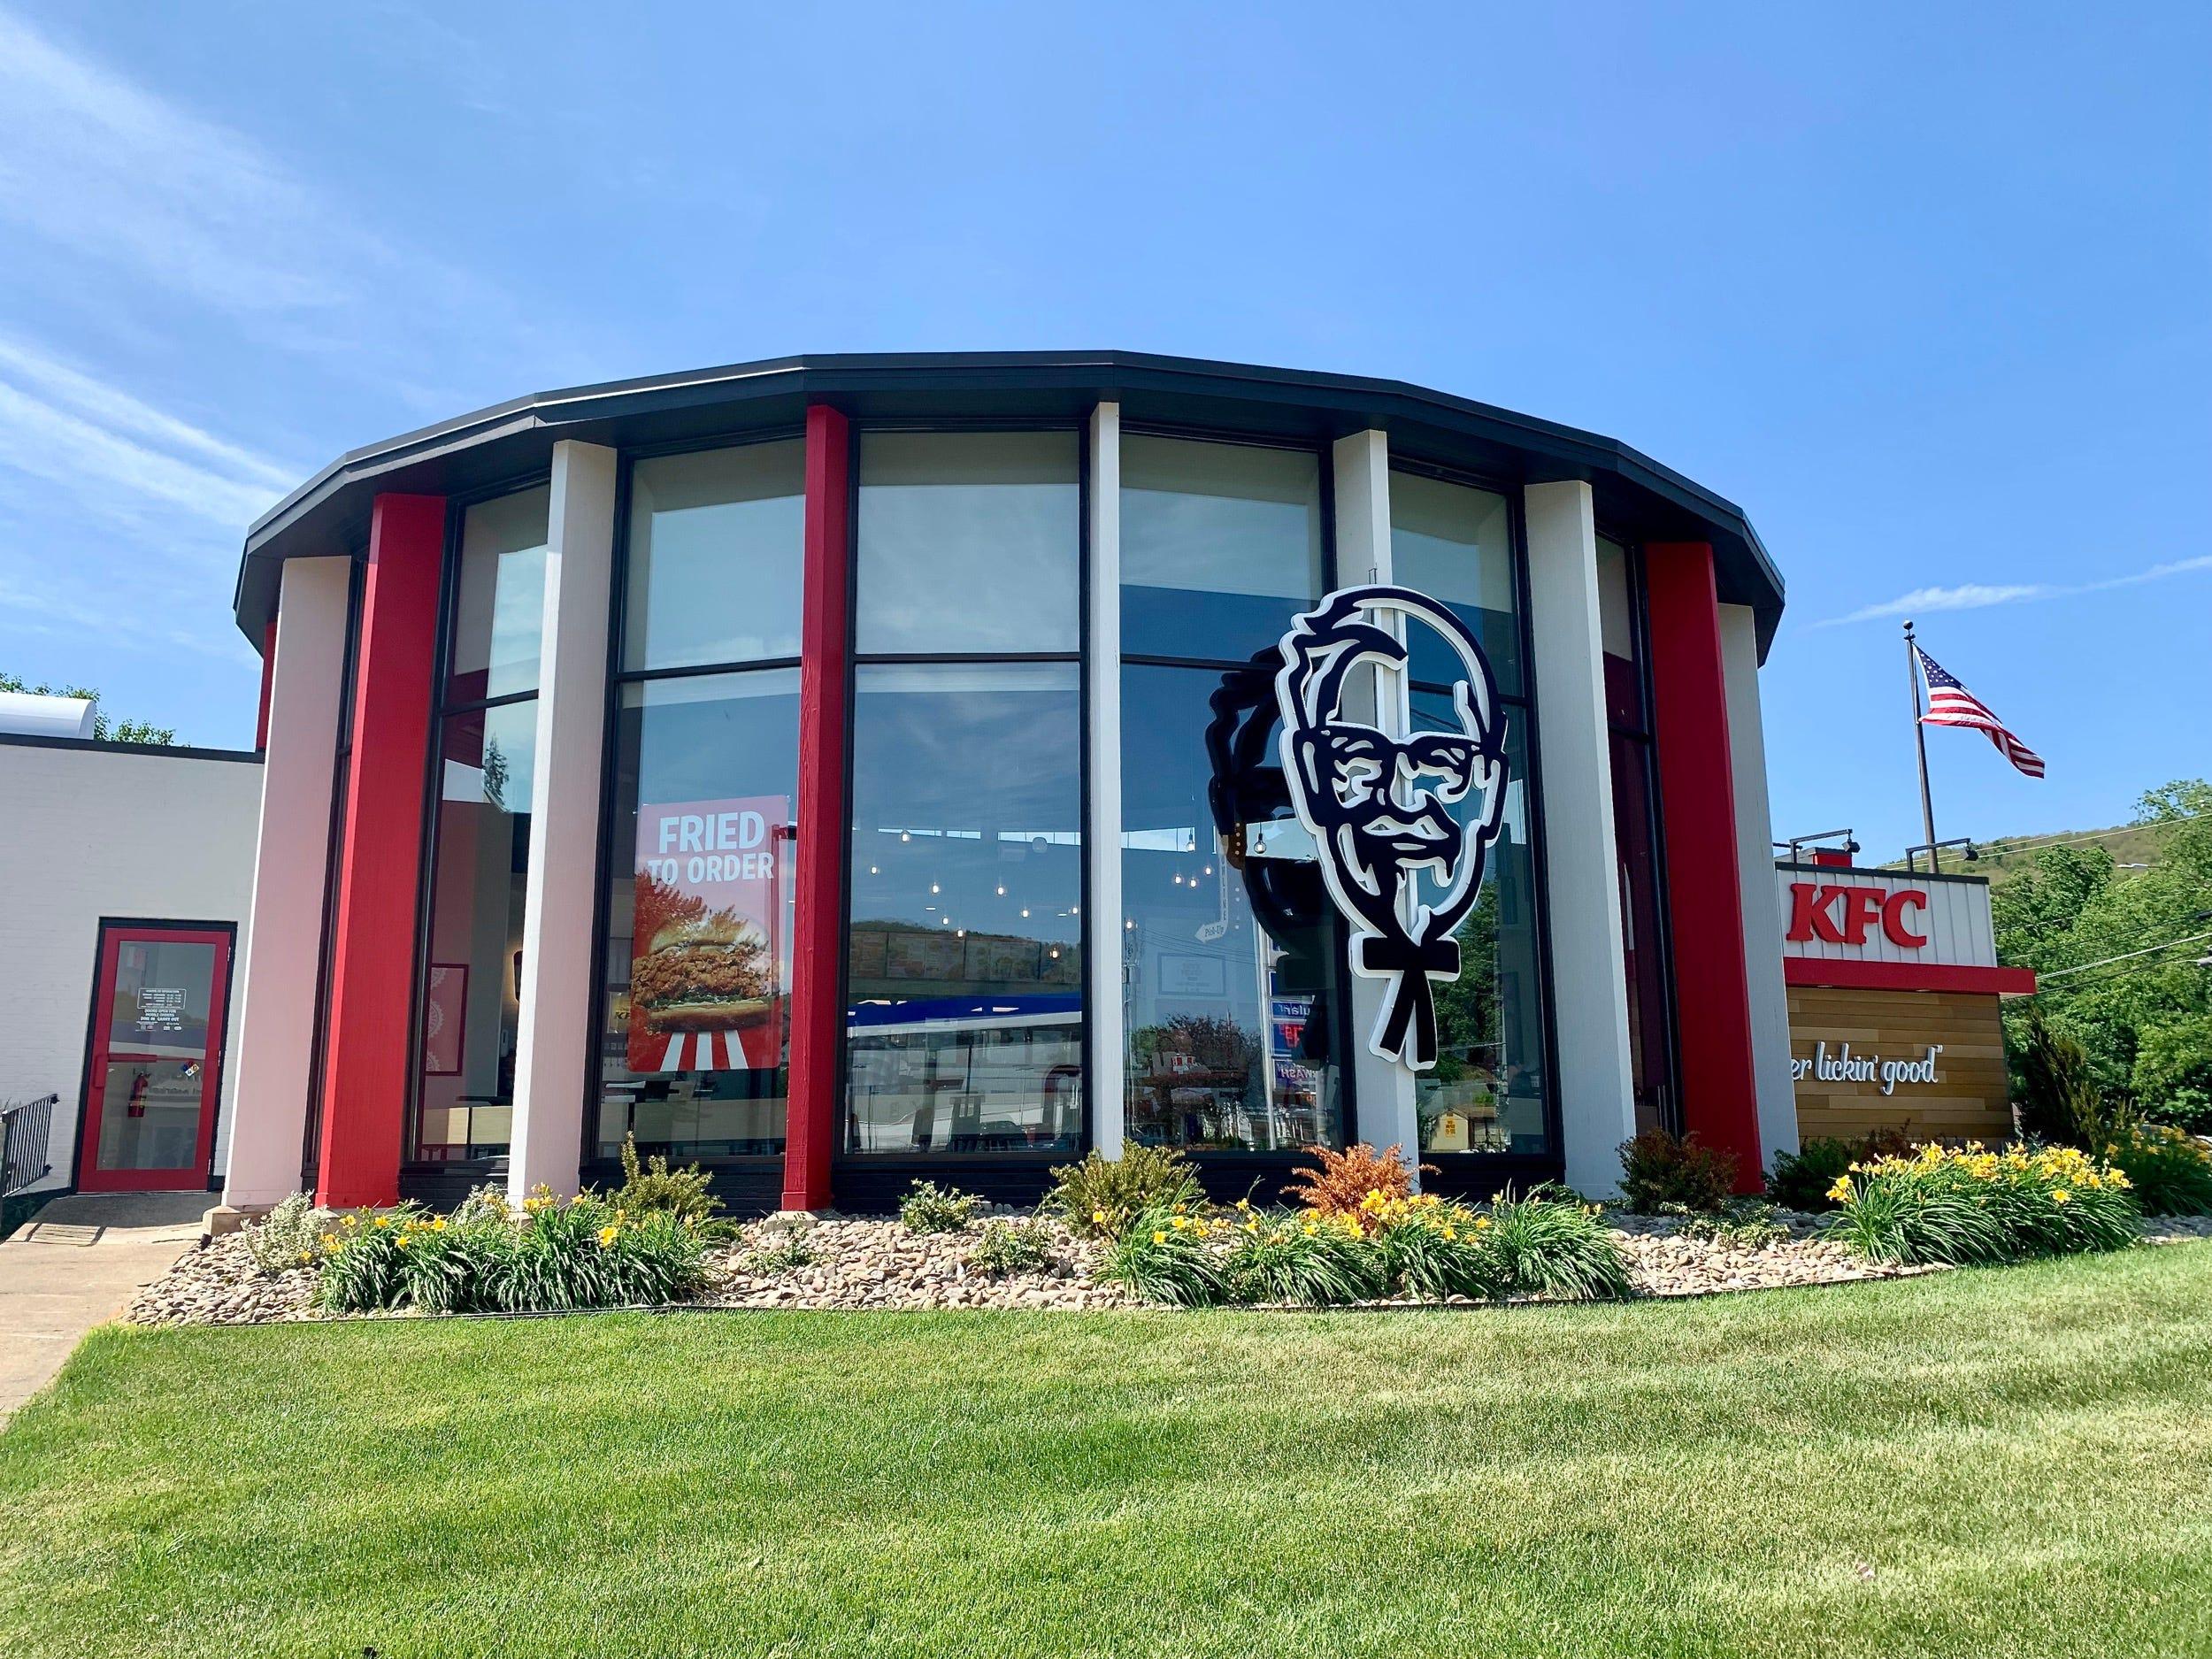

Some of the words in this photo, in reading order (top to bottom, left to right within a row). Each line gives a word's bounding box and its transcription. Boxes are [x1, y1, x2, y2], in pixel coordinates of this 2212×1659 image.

[658, 810, 764, 854] FRIED
[647, 858, 679, 886] TO
[687, 851, 774, 884] ORDER
[1786, 883, 1927, 948] KFC
[1816, 1041, 1878, 1081] lickin'
